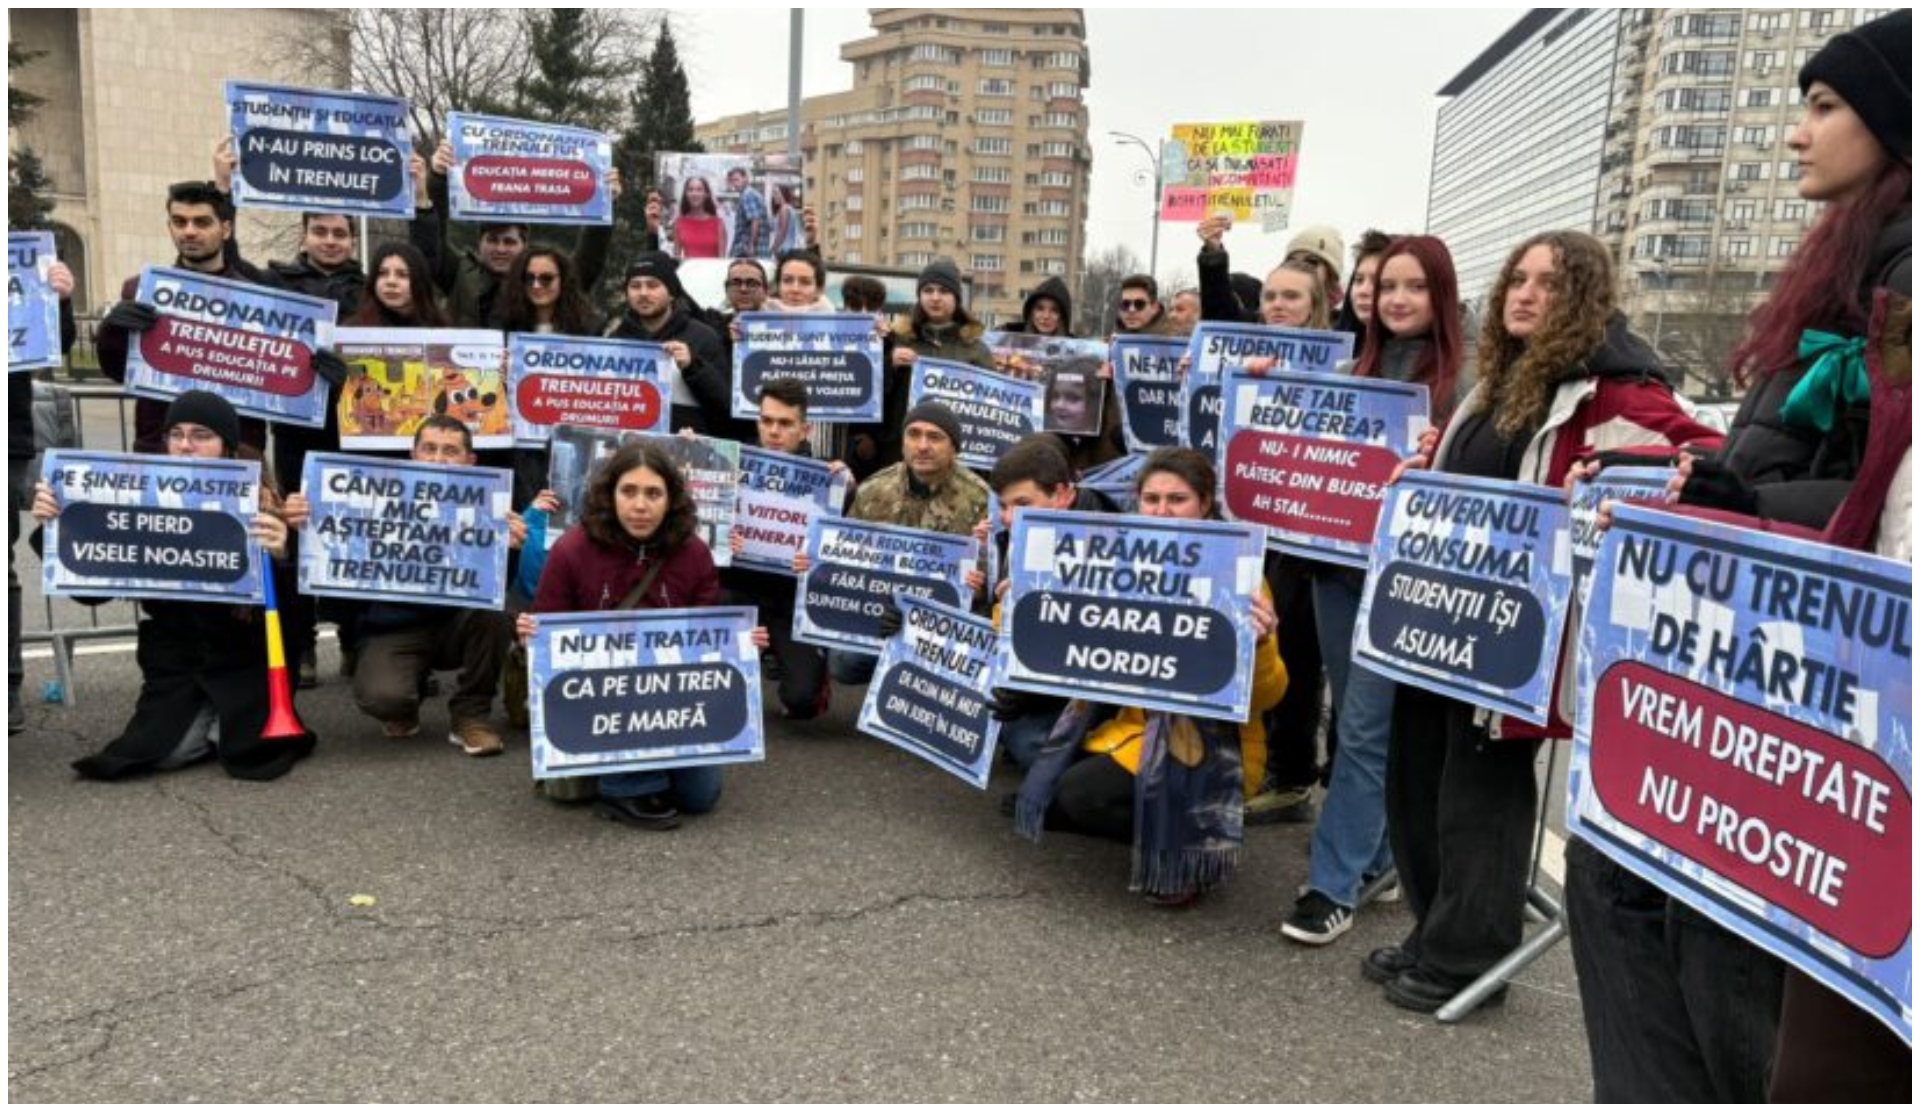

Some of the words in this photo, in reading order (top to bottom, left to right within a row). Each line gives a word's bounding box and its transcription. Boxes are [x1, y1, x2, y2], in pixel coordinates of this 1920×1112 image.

[462, 125, 485, 137] CU
[249, 137, 297, 156] N-AU
[303, 141, 354, 160] PRINS
[361, 147, 394, 163] LOC
[296, 169, 379, 194] TRENULEȚ
[531, 168, 569, 178] MERGE
[574, 171, 589, 179] CU
[169, 321, 294, 359] TRENULEȚUL
[1301, 345, 1330, 364] NU
[161, 342, 171, 353] A
[176, 344, 203, 359] PUS
[208, 352, 275, 373] EDUCAȚIA
[282, 366, 298, 378] PE
[540, 378, 641, 399] TRENULEȚUL
[1138, 388, 1164, 404] DAR
[1169, 392, 1181, 406] N
[1272, 386, 1304, 405] NE
[1311, 390, 1356, 412] TAIE
[533, 398, 542, 407] A
[546, 399, 569, 408] PUS
[574, 400, 628, 413] EDUCAȚIA
[633, 403, 646, 412] PE
[1250, 405, 1385, 439] REDUCEREA?
[1303, 446, 1360, 467] NIMIC
[52, 470, 76, 485] PE
[82, 473, 149, 493] ȘINELE
[157, 477, 251, 498] VOASTRE
[769, 465, 789, 478] DE
[1236, 462, 1285, 485] PLĂTESC
[1289, 474, 1323, 491] DIN
[330, 470, 404, 497] CÂND
[414, 481, 484, 504] ERAM
[382, 502, 431, 522] MIC
[1252, 495, 1269, 510] AH
[1407, 490, 1540, 538] GUVERNUL
[107, 512, 129, 530] SE
[137, 515, 192, 534] PIERD
[318, 516, 450, 543] AȘTEPTAM
[460, 529, 494, 547] CU
[73, 543, 138, 563] VISELE
[144, 548, 240, 569] NOASTRE
[370, 542, 442, 563] DRAG
[1055, 534, 1077, 558] A
[1088, 531, 1203, 567] RĂMAS
[1399, 530, 1533, 583] CONSUMĂ
[330, 559, 479, 591] TRENULEȚUL
[830, 573, 864, 590] FĂRĂ
[1059, 562, 1195, 598] VIITORUL
[808, 593, 859, 611] SUNTEM
[1390, 575, 1485, 623] STUDENȚII
[1489, 590, 1523, 634] ÎȘI
[1619, 535, 1674, 585] NU
[1687, 551, 1734, 599] CU
[1752, 563, 1911, 657] TRENUL
[1039, 594, 1070, 623] ÎN
[1080, 605, 1161, 635] GARA
[1173, 614, 1211, 639] DE
[561, 635, 596, 653] NU
[605, 633, 636, 650] NE
[643, 628, 729, 649] TRATAȚI
[1393, 626, 1478, 671] ASUMĂ
[1066, 645, 1178, 679] NORDIS
[1652, 613, 1698, 664] DE
[1710, 628, 1862, 722] HÂRTIE
[563, 678, 594, 699] CA
[603, 676, 627, 697] PE
[635, 673, 669, 694] UN
[677, 670, 732, 691] TREN
[899, 671, 911, 687] DE
[957, 699, 982, 718] MUT
[592, 714, 621, 735] DE
[628, 703, 707, 732] MARFĂ
[886, 696, 907, 714] DIN
[909, 705, 935, 733] JUDEȚ
[949, 727, 979, 754] JUDEȚ
[1621, 677, 1702, 748] VREM
[1711, 716, 1891, 834] DREPTATE
[1639, 766, 1691, 823] NU
[1698, 797, 1846, 907] PROSTIE
